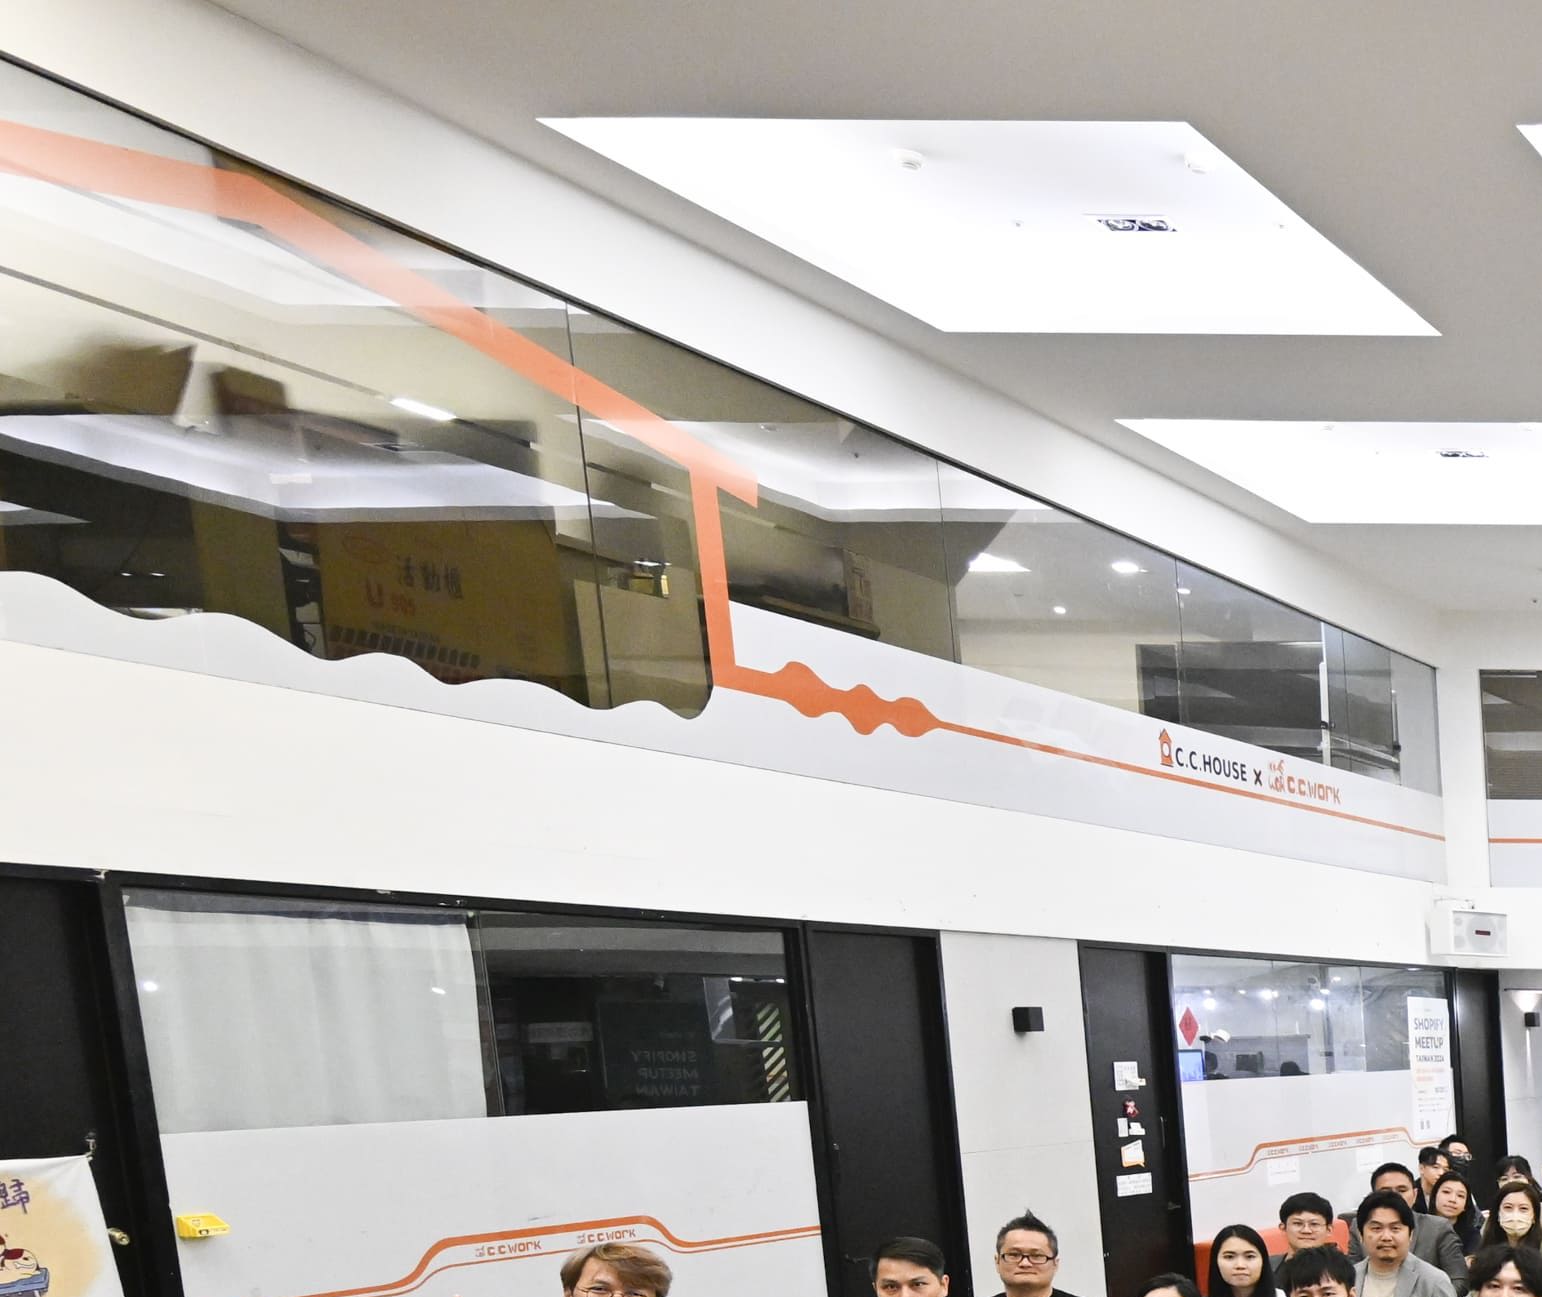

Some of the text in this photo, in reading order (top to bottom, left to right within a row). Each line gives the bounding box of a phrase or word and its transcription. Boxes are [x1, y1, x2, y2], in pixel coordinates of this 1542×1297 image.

[1175, 748, 1247, 782] C.C.HOUSE
[1413, 1018, 1444, 1031] SHOPIFY
[1415, 1036, 1443, 1049] MEETUP
